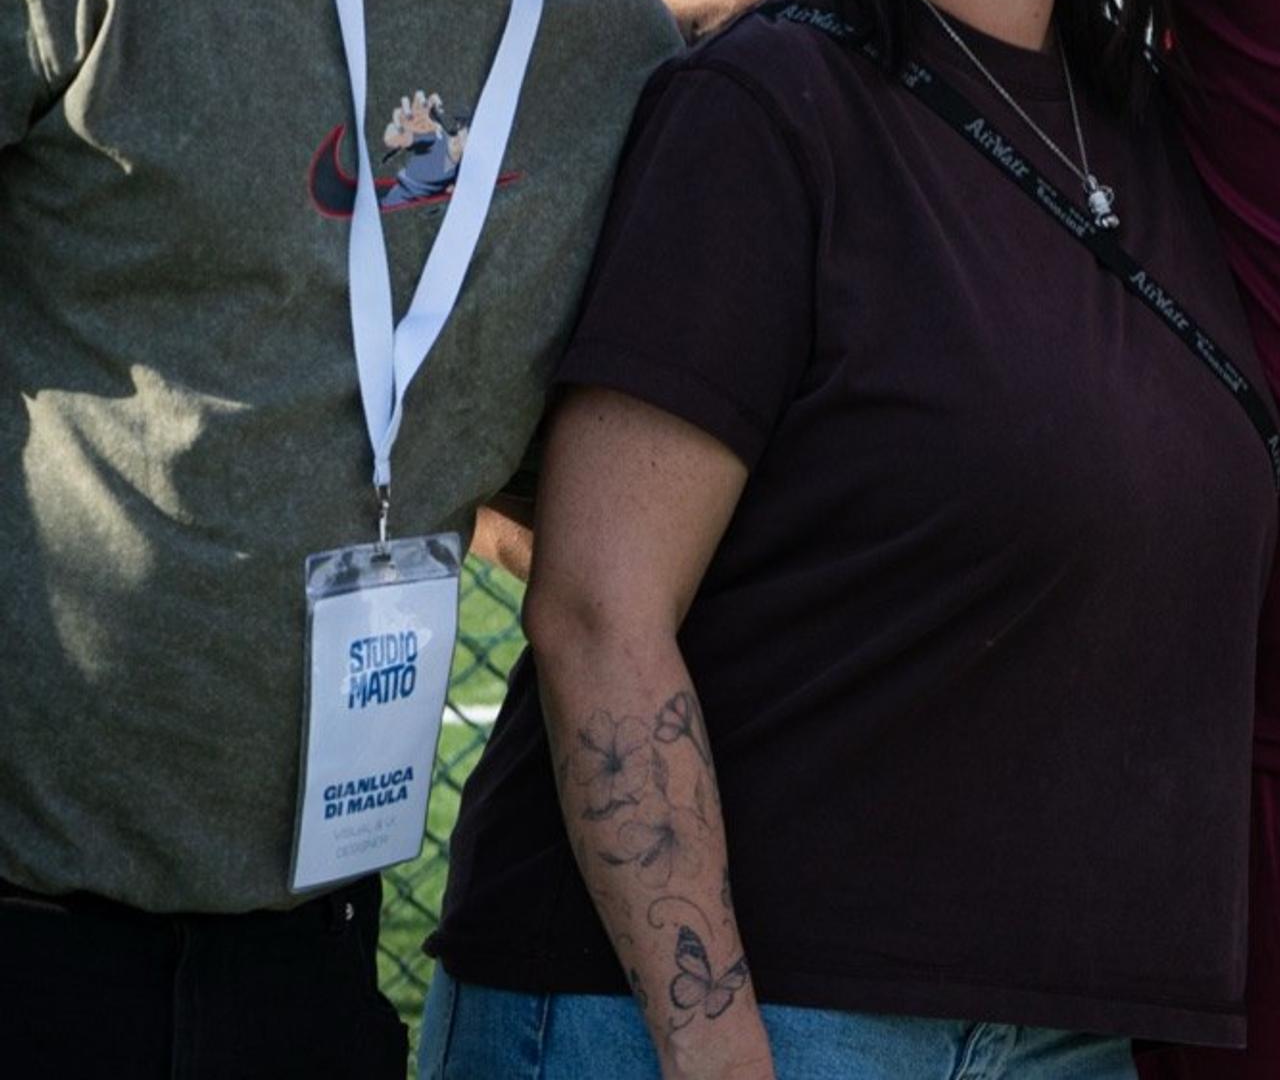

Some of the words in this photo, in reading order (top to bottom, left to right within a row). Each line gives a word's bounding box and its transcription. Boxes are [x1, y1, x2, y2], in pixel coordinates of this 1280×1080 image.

[348, 629, 419, 673] STUDIO
[347, 663, 418, 710] MATTO
[323, 765, 415, 803] GIANLUCA
[324, 800, 345, 820] DI
[346, 785, 409, 816] MAULA
